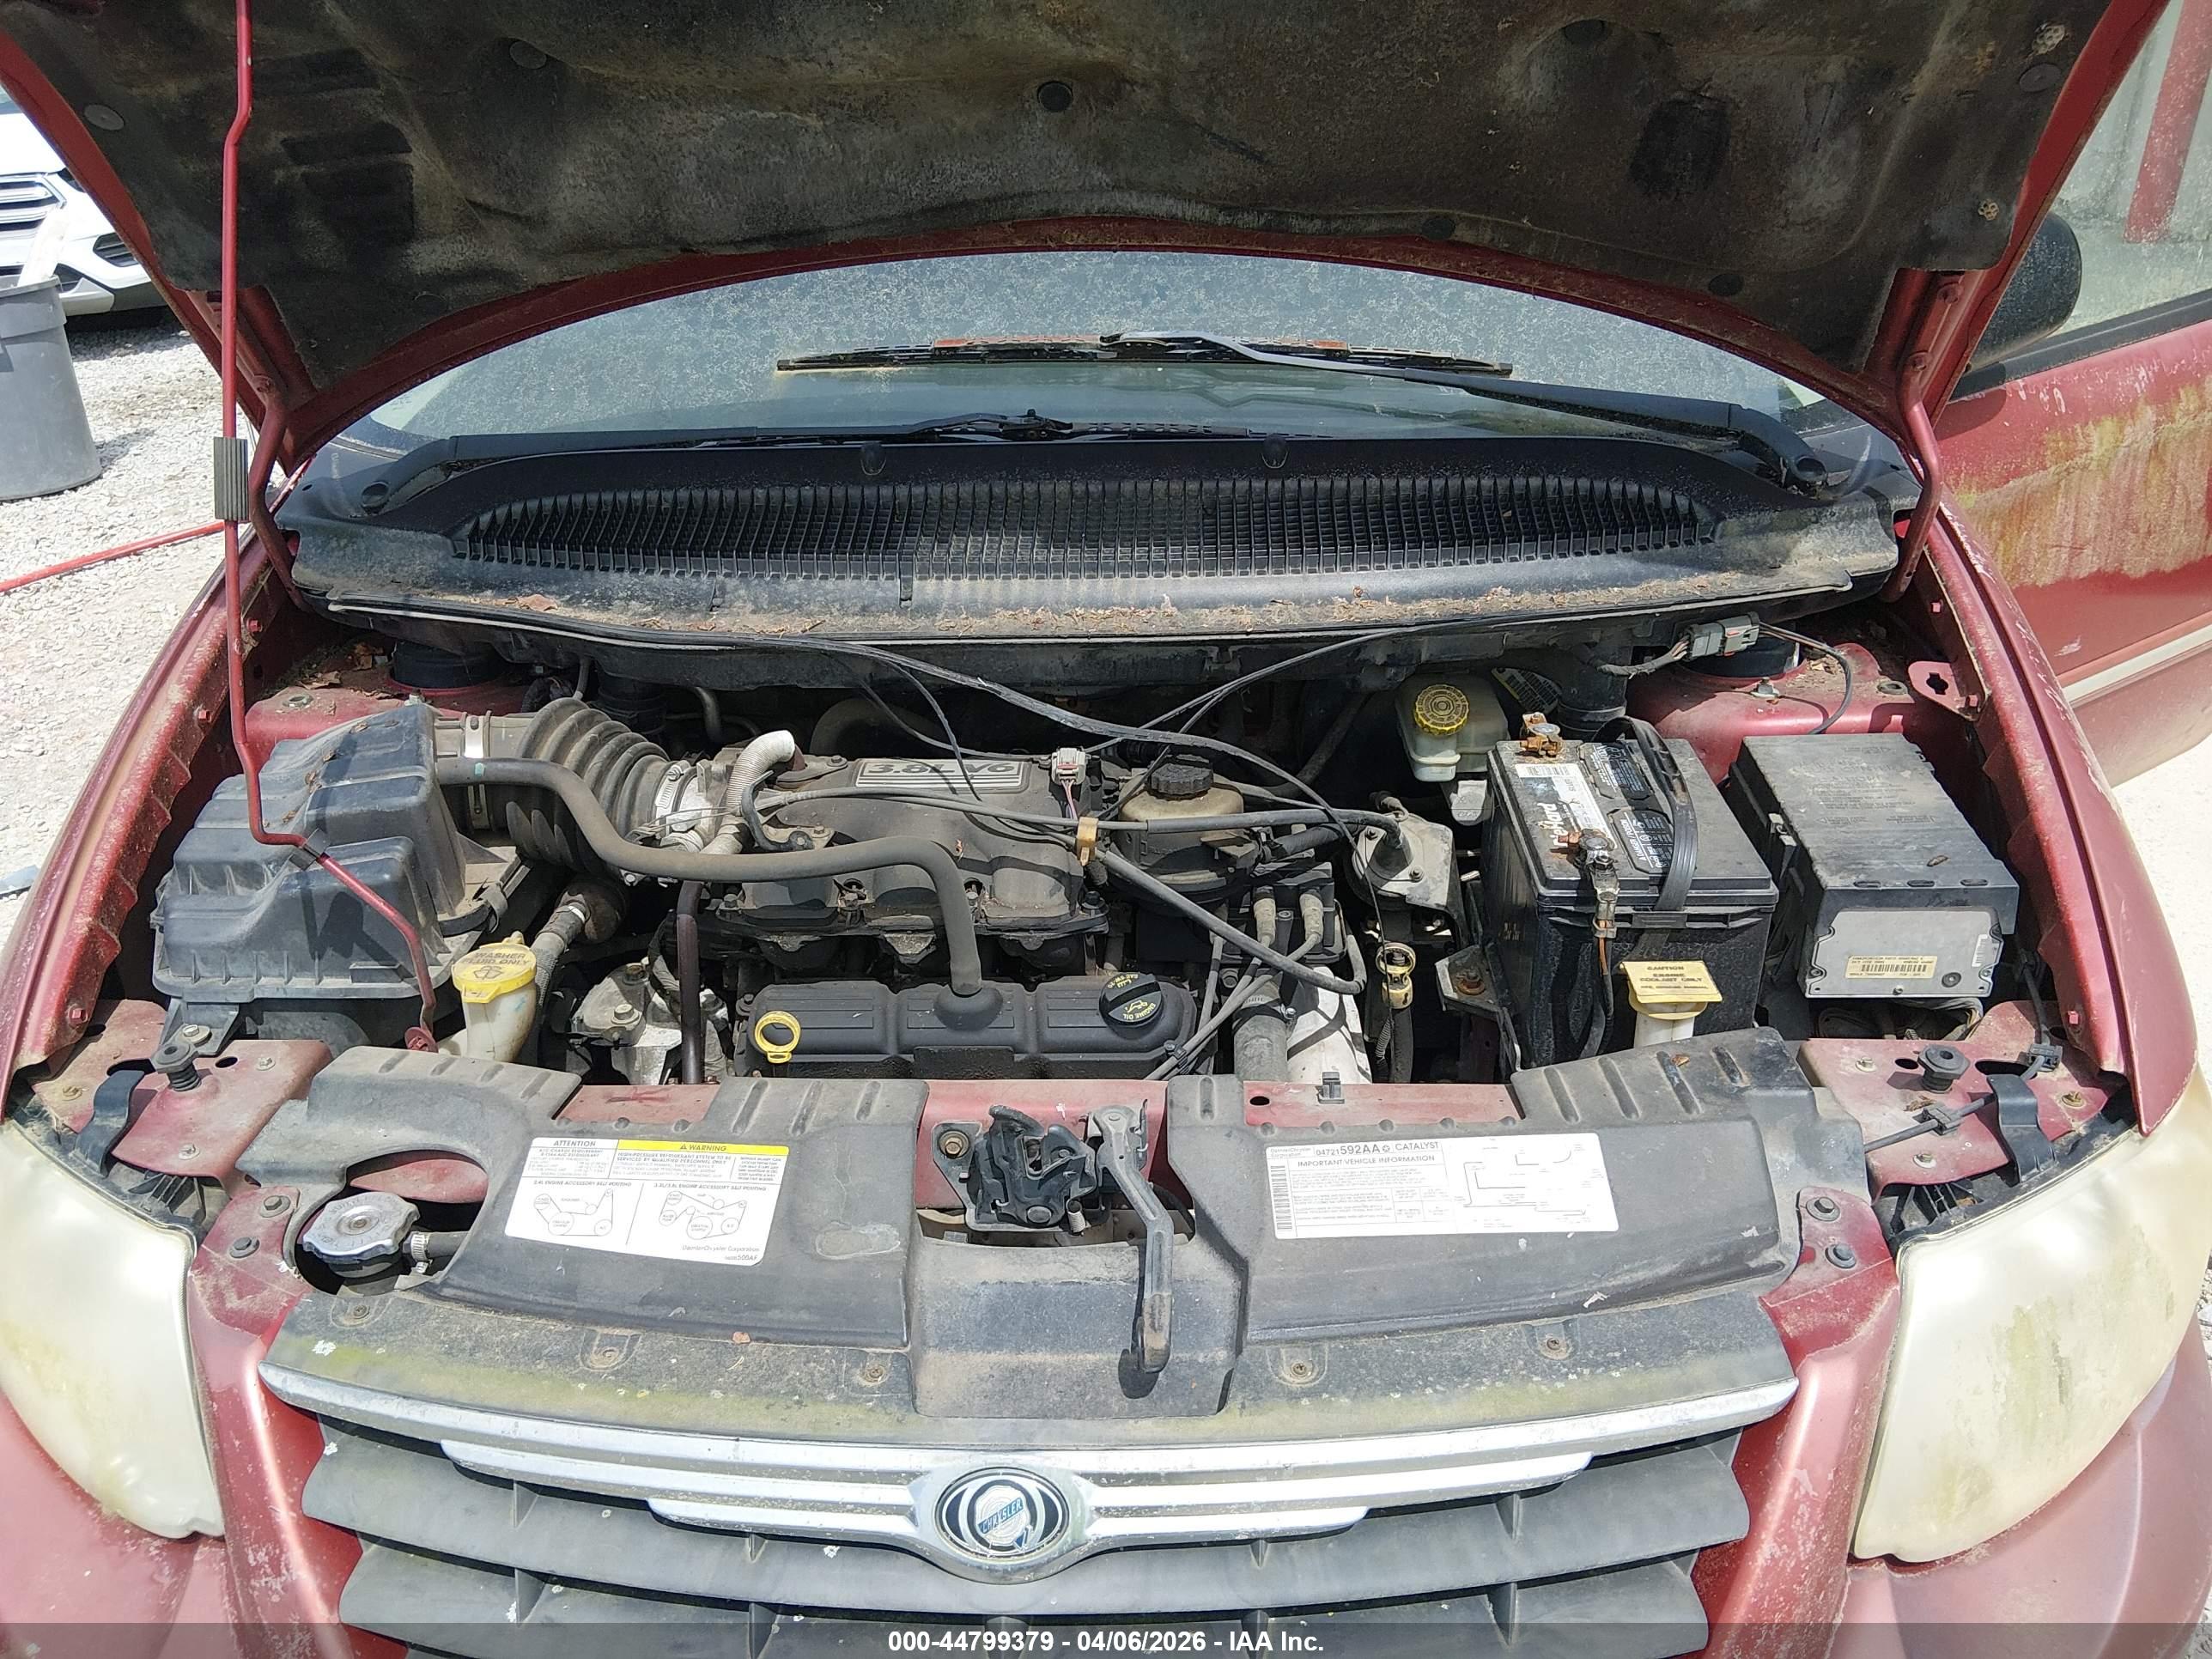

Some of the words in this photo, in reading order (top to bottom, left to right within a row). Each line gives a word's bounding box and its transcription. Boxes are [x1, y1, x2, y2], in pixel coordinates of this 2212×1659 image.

[868, 763, 955, 773] 3.8L
[964, 763, 1015, 773] V6
[1135, 1002, 1157, 1019] ENGINE
[1316, 1143, 1381, 1156] 04721592AA
[1395, 1141, 1439, 1151] CATALYST
[982, 1498, 1023, 1534] CHRYSLER
